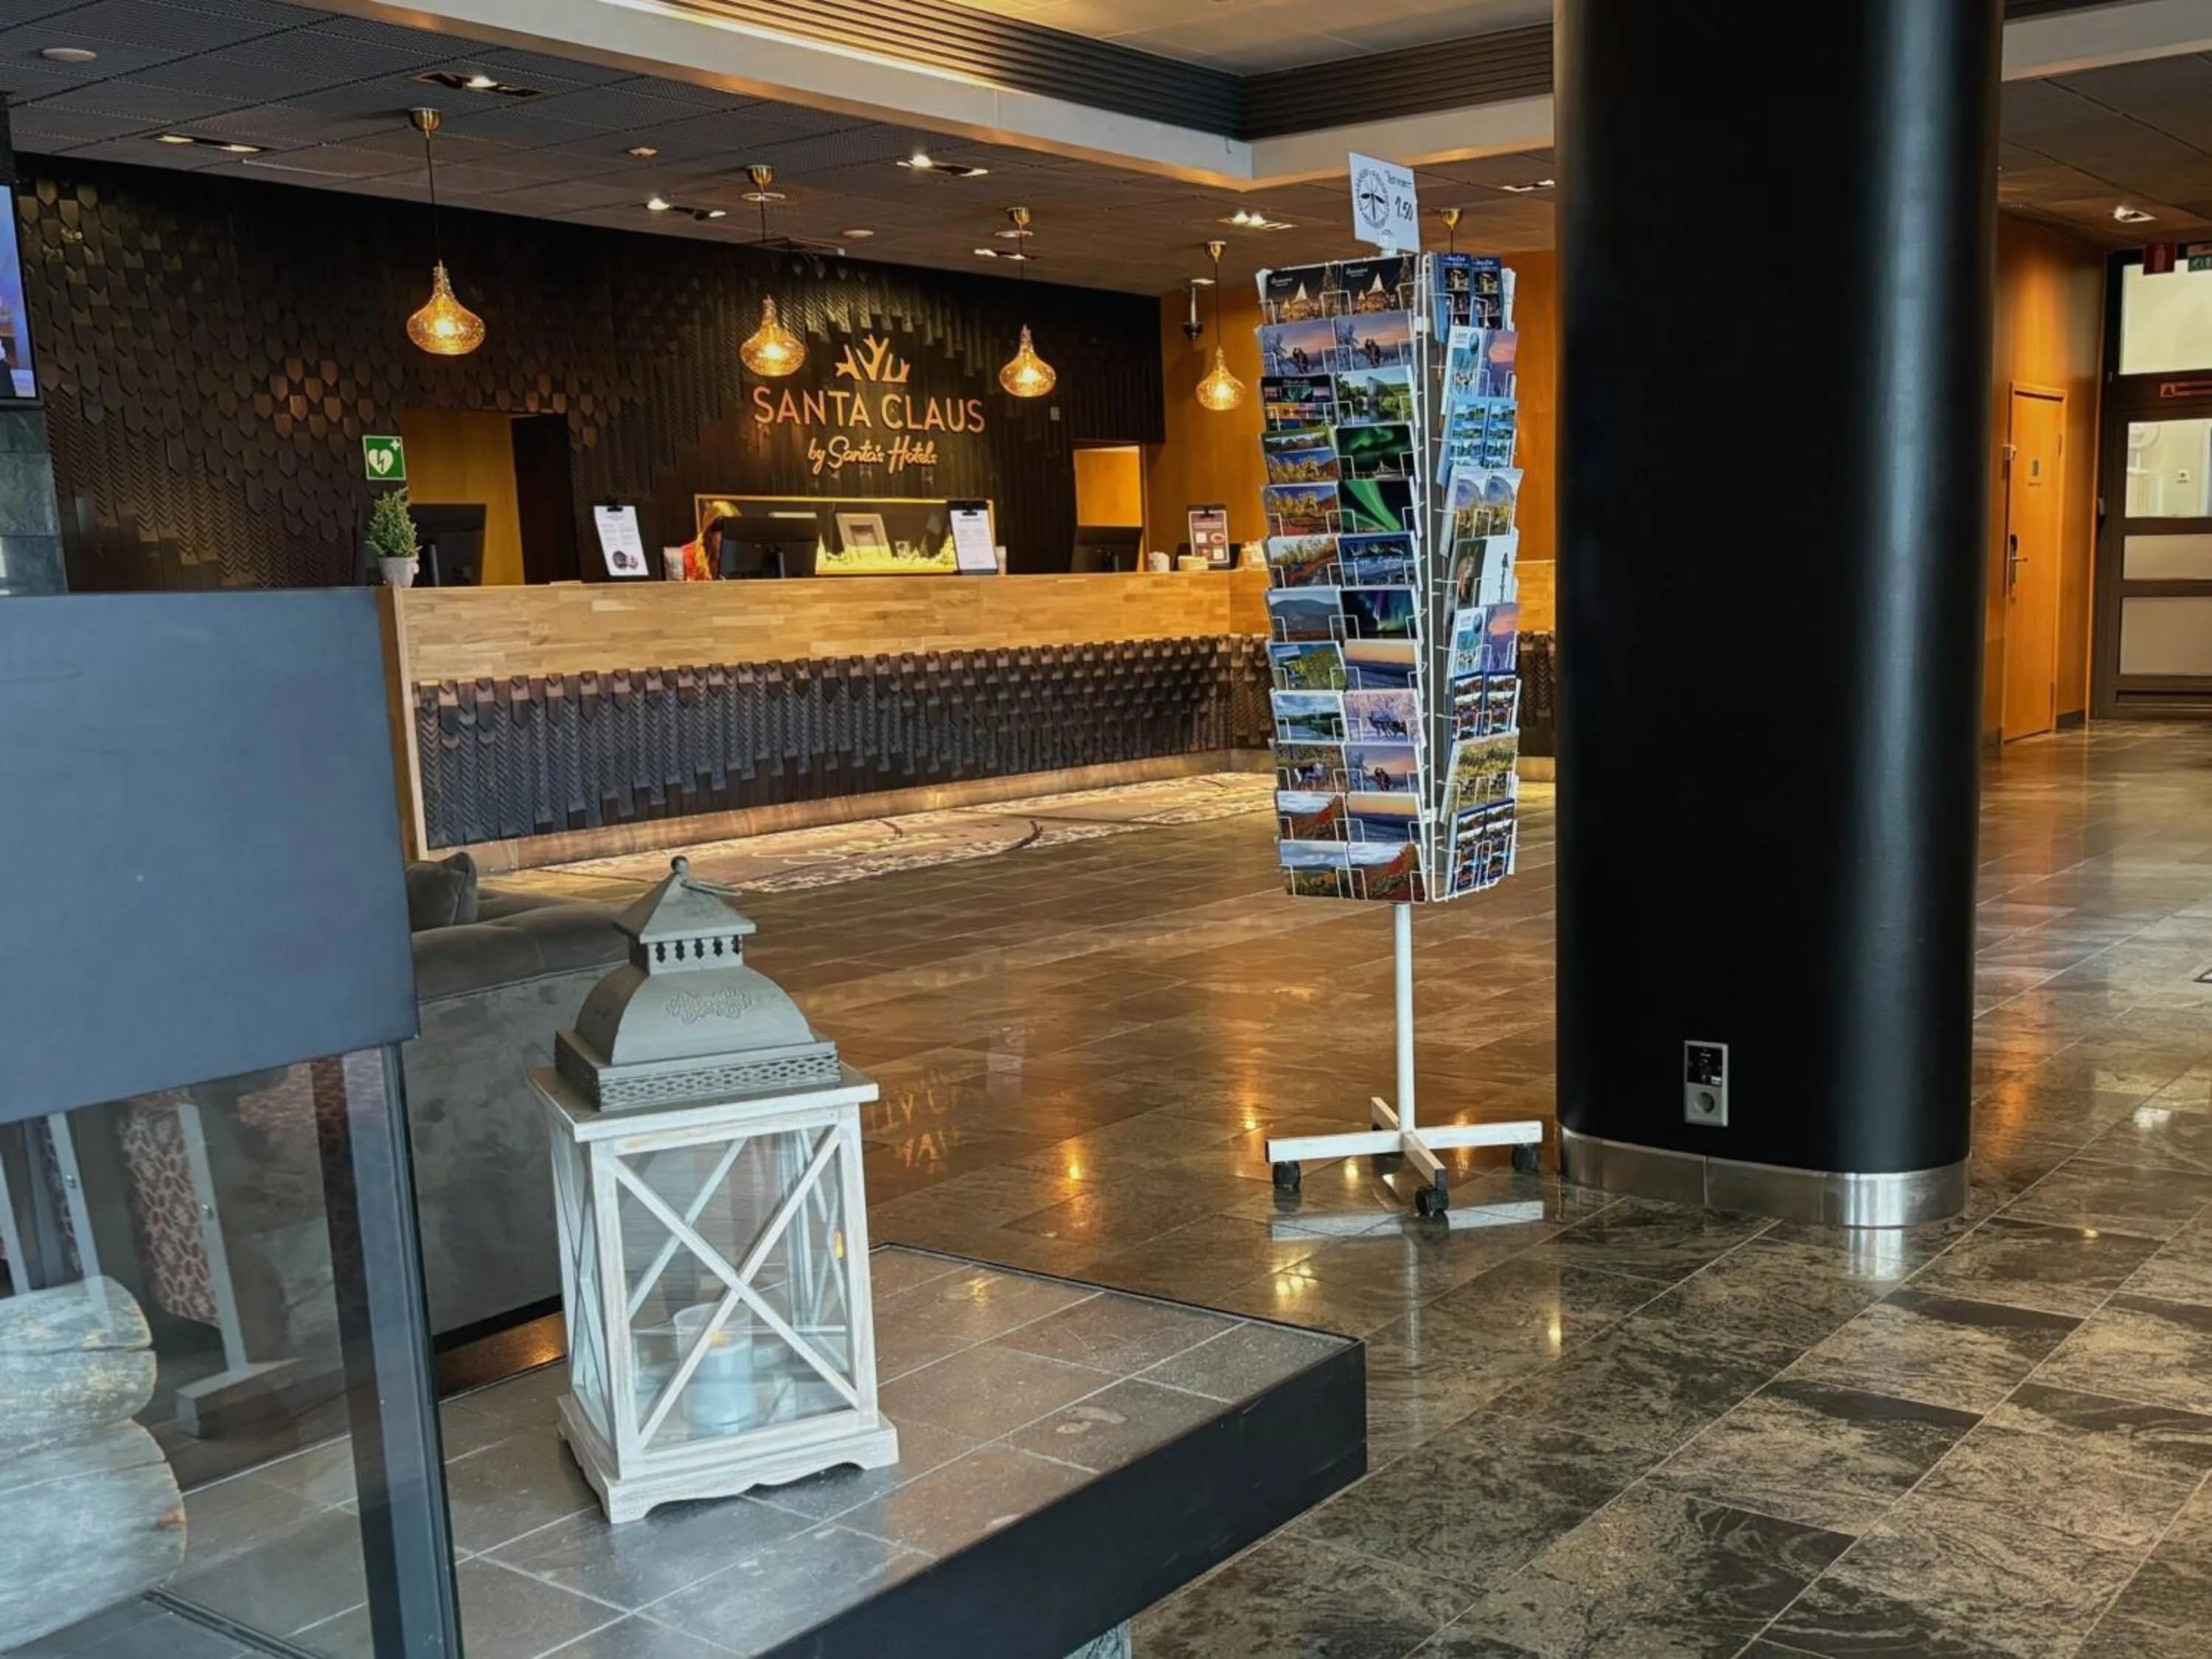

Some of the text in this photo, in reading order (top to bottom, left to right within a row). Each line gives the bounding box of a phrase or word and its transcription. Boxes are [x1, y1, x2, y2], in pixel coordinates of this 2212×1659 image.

[753, 386, 985, 434] SANTA CLAUS
[807, 437, 827, 476] by
[887, 434, 939, 474] Hotels
